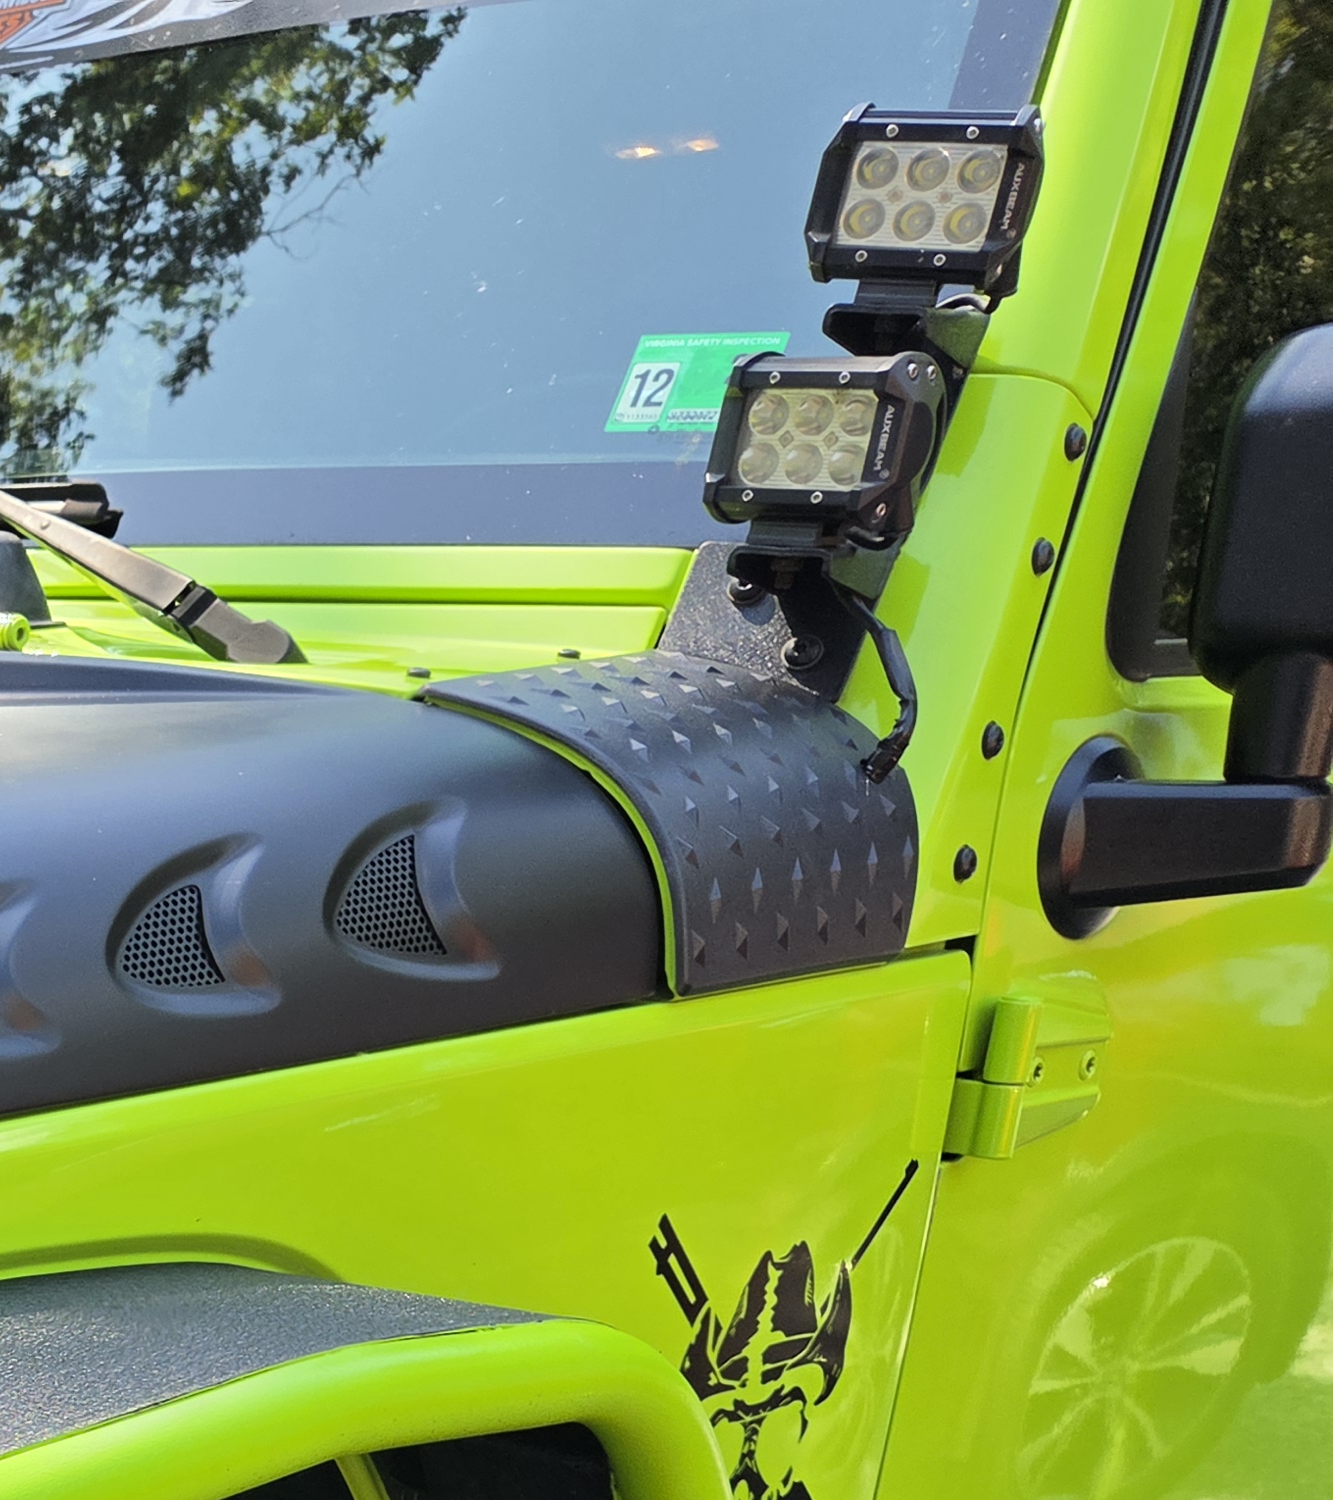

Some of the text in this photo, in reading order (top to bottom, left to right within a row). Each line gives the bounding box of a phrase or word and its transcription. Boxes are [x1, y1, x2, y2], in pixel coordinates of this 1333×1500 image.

[644, 336, 781, 348] VIRGINIA SAFETY INSPECTION
[629, 368, 675, 408] 12
